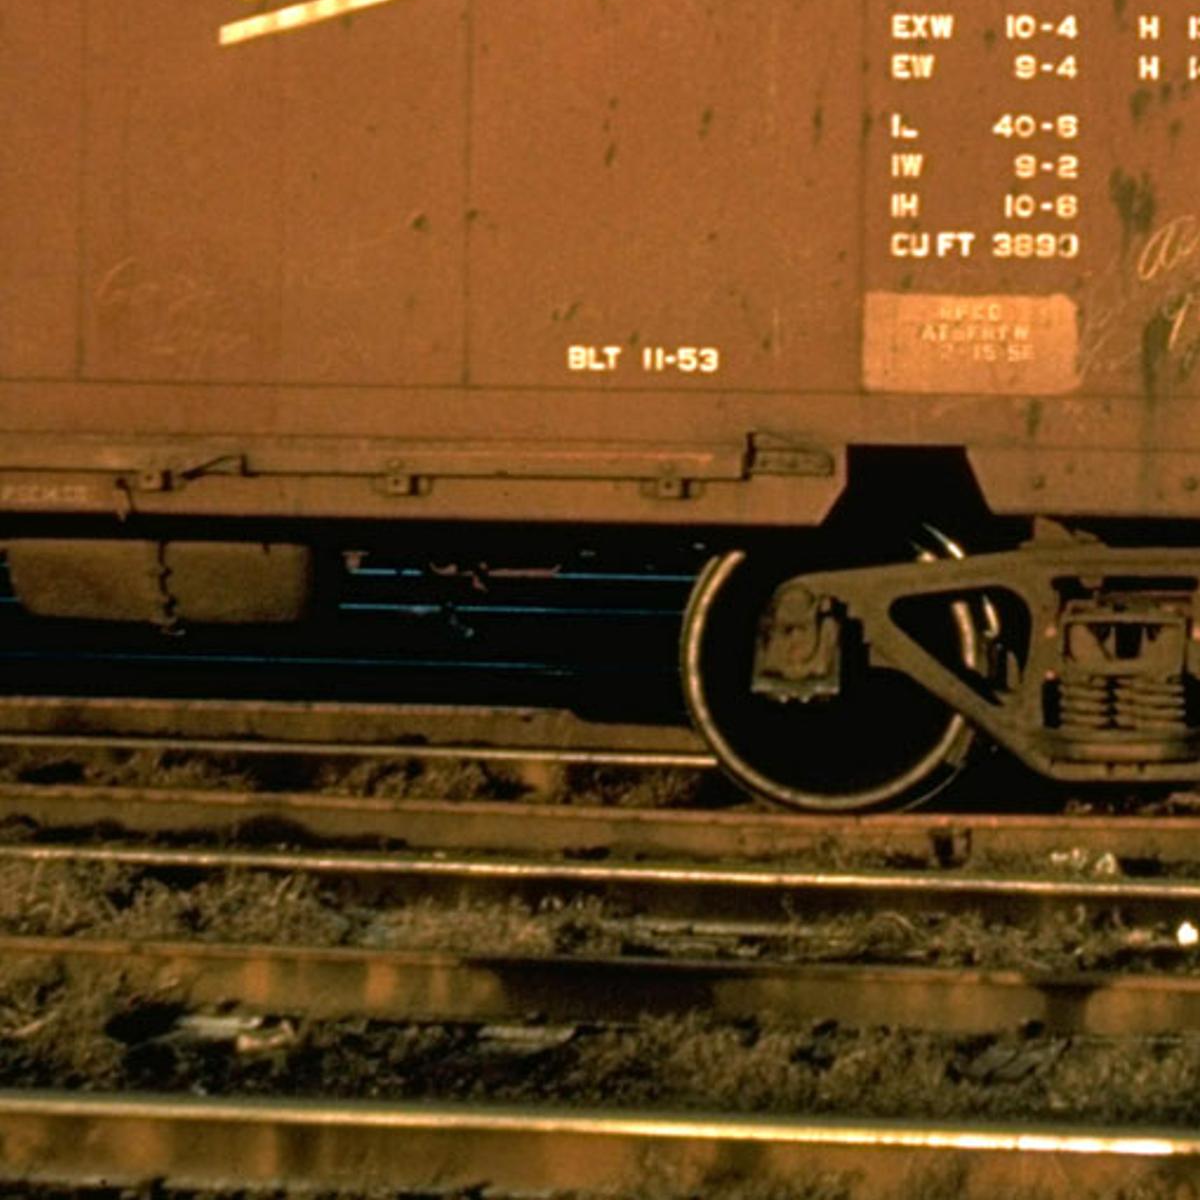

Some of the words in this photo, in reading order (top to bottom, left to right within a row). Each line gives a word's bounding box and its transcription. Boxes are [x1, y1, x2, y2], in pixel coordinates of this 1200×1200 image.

[891, 14, 954, 40] EXW
[1005, 14, 1078, 39] 10-4
[1138, 15, 1160, 40] H
[891, 53, 935, 80] EW
[1014, 54, 1078, 80] 9-4
[1138, 55, 1160, 80] H
[891, 153, 924, 178] IW
[1014, 154, 1079, 179] 9-2
[891, 193, 919, 218] IH
[568, 345, 622, 371] BLT
[643, 346, 719, 373] 11-53
